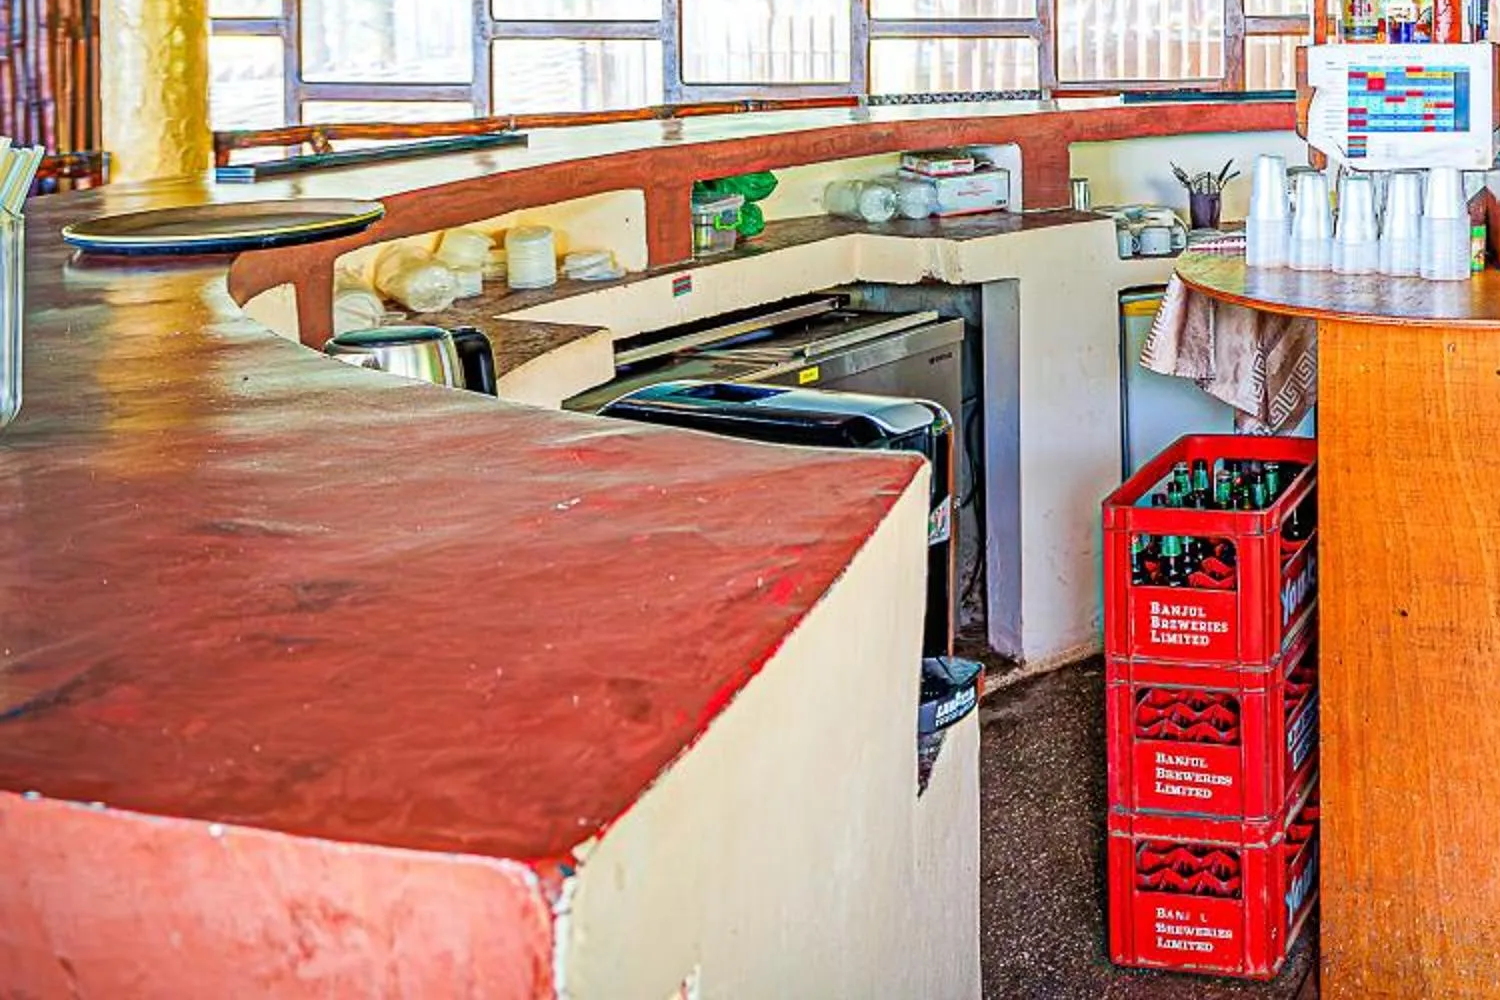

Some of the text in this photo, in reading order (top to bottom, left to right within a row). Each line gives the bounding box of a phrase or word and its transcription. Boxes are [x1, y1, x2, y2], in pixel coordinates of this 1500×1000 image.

[1150, 600, 1207, 618] BANJUL
[1150, 615, 1229, 633] BREWERIES
[1150, 629, 1211, 647] LIMITED
[1154, 750, 1209, 769] BANJUL
[1154, 766, 1234, 787] BREWERIES
[1154, 780, 1214, 800] LIMITED
[1154, 921, 1234, 940] BREWERIES
[1155, 935, 1216, 953] LIMITED
